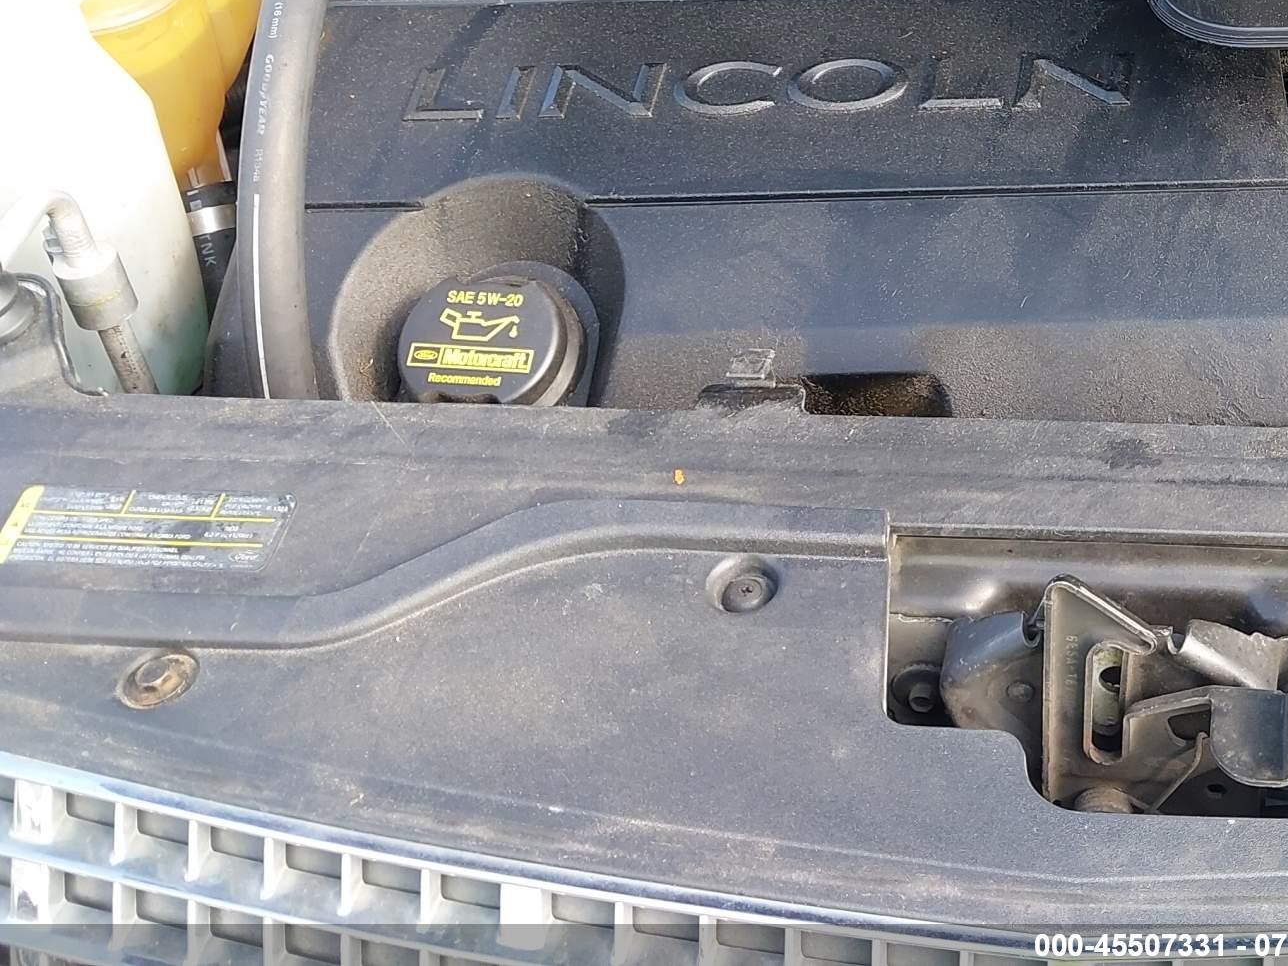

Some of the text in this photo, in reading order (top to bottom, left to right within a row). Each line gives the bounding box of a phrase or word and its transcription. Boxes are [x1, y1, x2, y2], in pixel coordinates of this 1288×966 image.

[402, 52, 1131, 122] LINCOLN
[446, 290, 524, 307] SAE 5W-20
[443, 347, 528, 370] Motorcraft
[427, 372, 502, 387] Recommended
